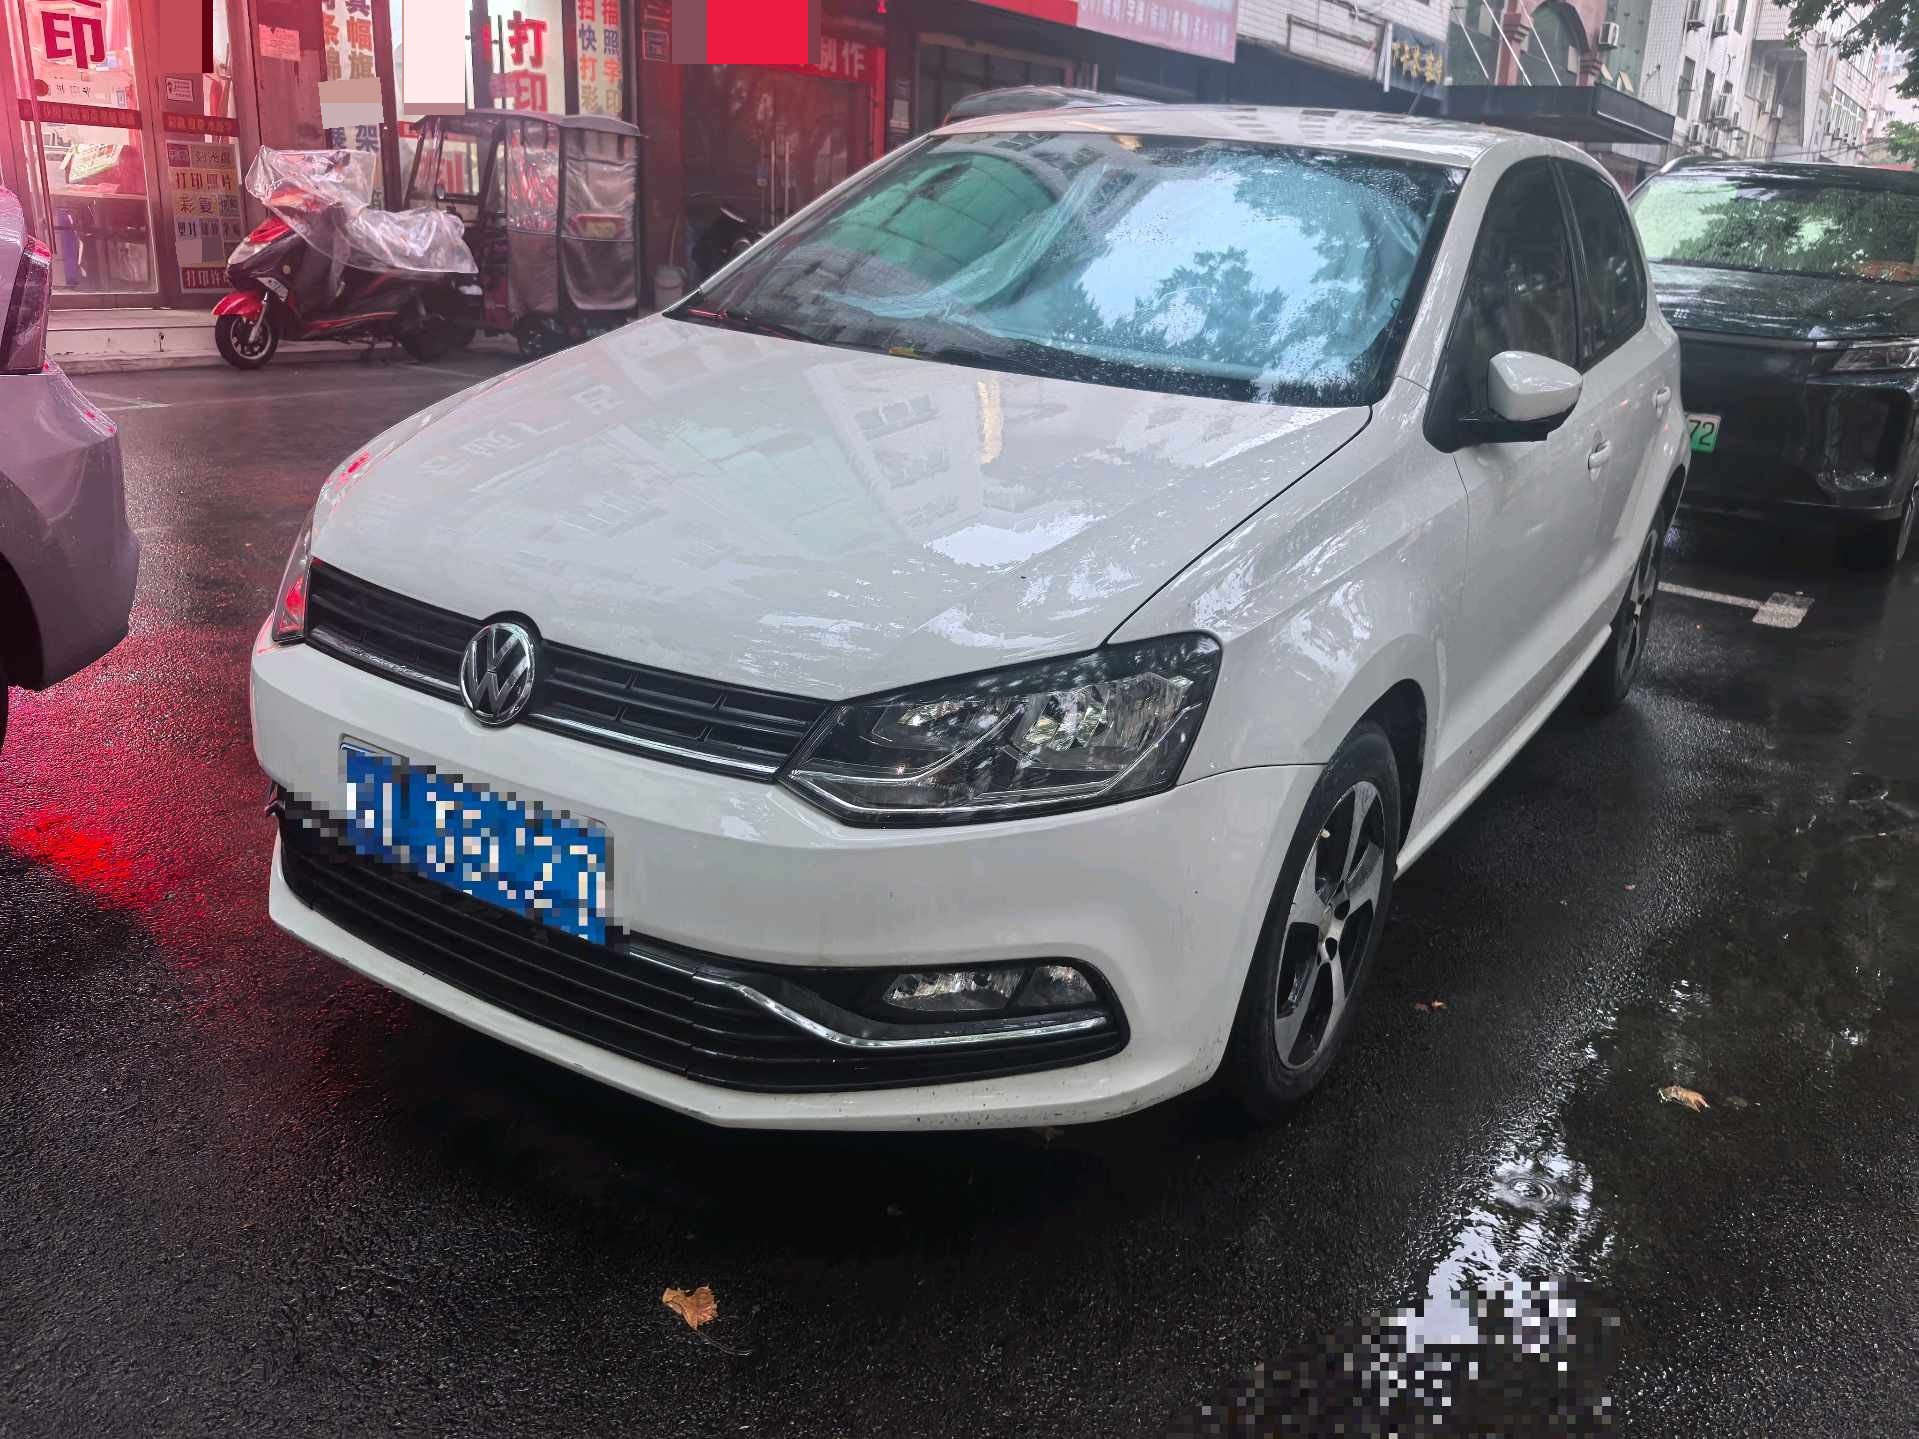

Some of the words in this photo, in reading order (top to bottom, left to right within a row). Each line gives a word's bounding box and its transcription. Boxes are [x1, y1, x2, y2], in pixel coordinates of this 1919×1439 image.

[41, 10, 105, 69] 印
[507, 10, 548, 112] 打印
[579, 54, 623, 86] 打字
